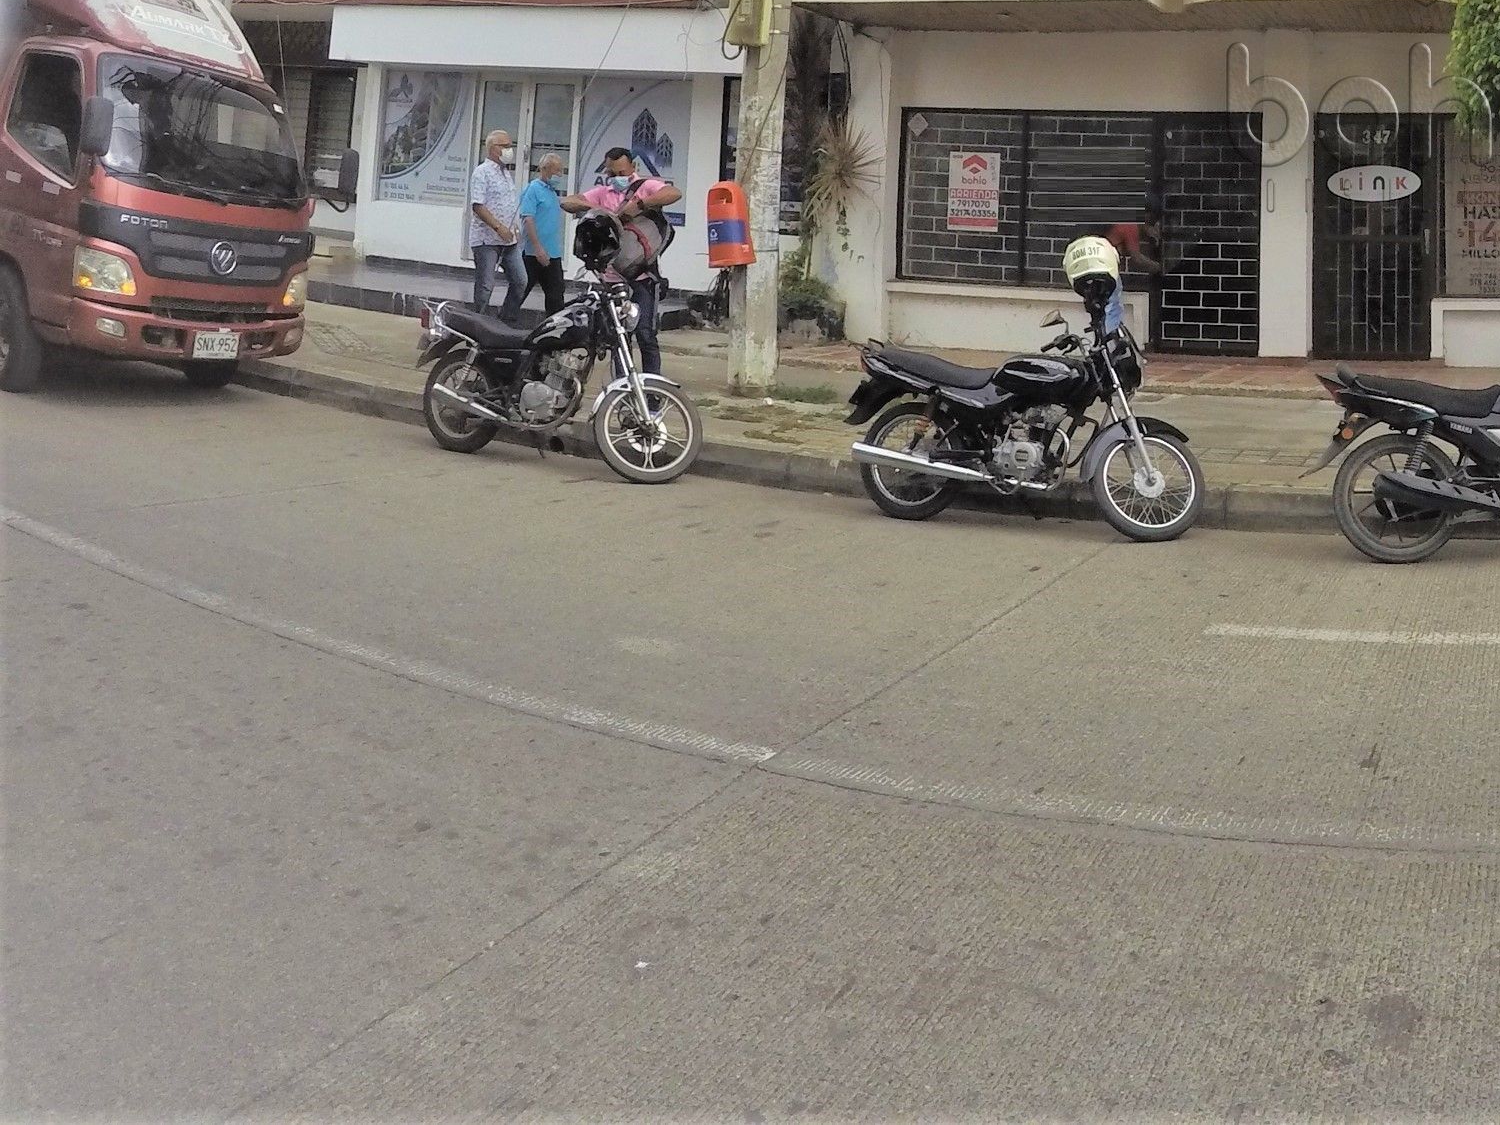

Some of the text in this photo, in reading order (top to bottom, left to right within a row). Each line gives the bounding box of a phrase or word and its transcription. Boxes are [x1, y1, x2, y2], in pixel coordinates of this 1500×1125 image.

[950, 188, 999, 200] ARRIENDA
[957, 199, 991, 209] 7917070
[119, 213, 169, 229] FOTON
